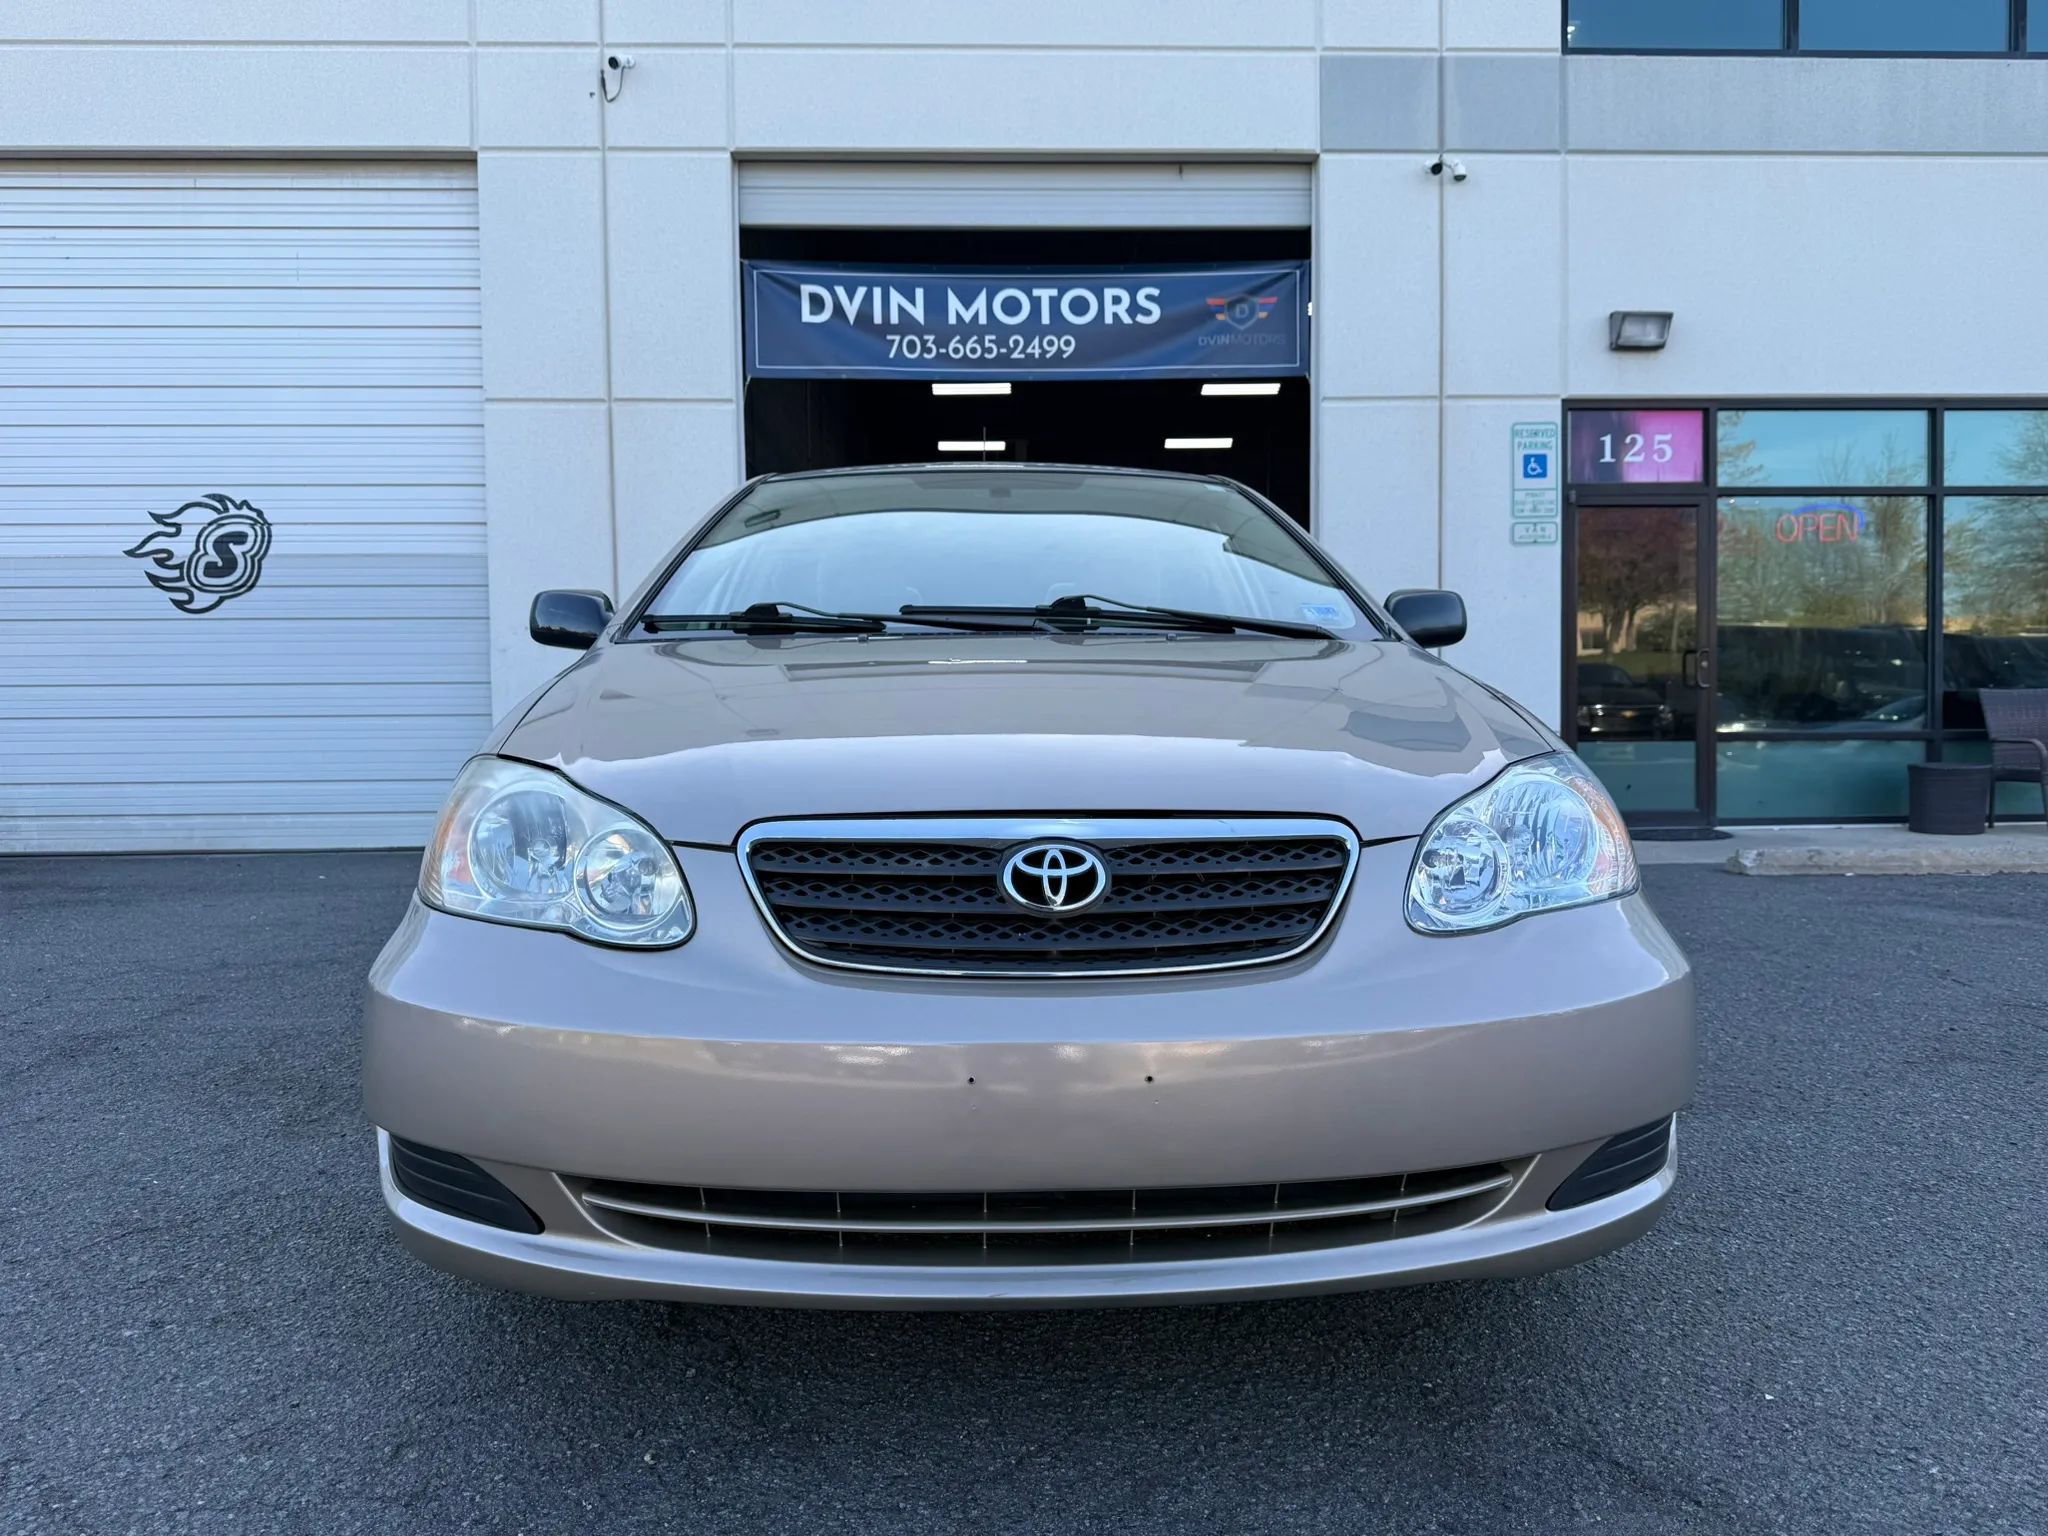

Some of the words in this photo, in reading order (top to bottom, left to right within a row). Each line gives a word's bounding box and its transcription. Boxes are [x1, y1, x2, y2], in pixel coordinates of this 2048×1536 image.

[801, 284, 925, 324] DVIN
[947, 286, 1162, 325] MOTORS
[1235, 303, 1250, 319] D
[886, 335, 1076, 360] 703-665-2499
[1515, 428, 1555, 438] RESERVED
[1517, 440, 1553, 450] PARKING
[1599, 433, 1673, 463] 125
[1776, 511, 1860, 544] OPEN
